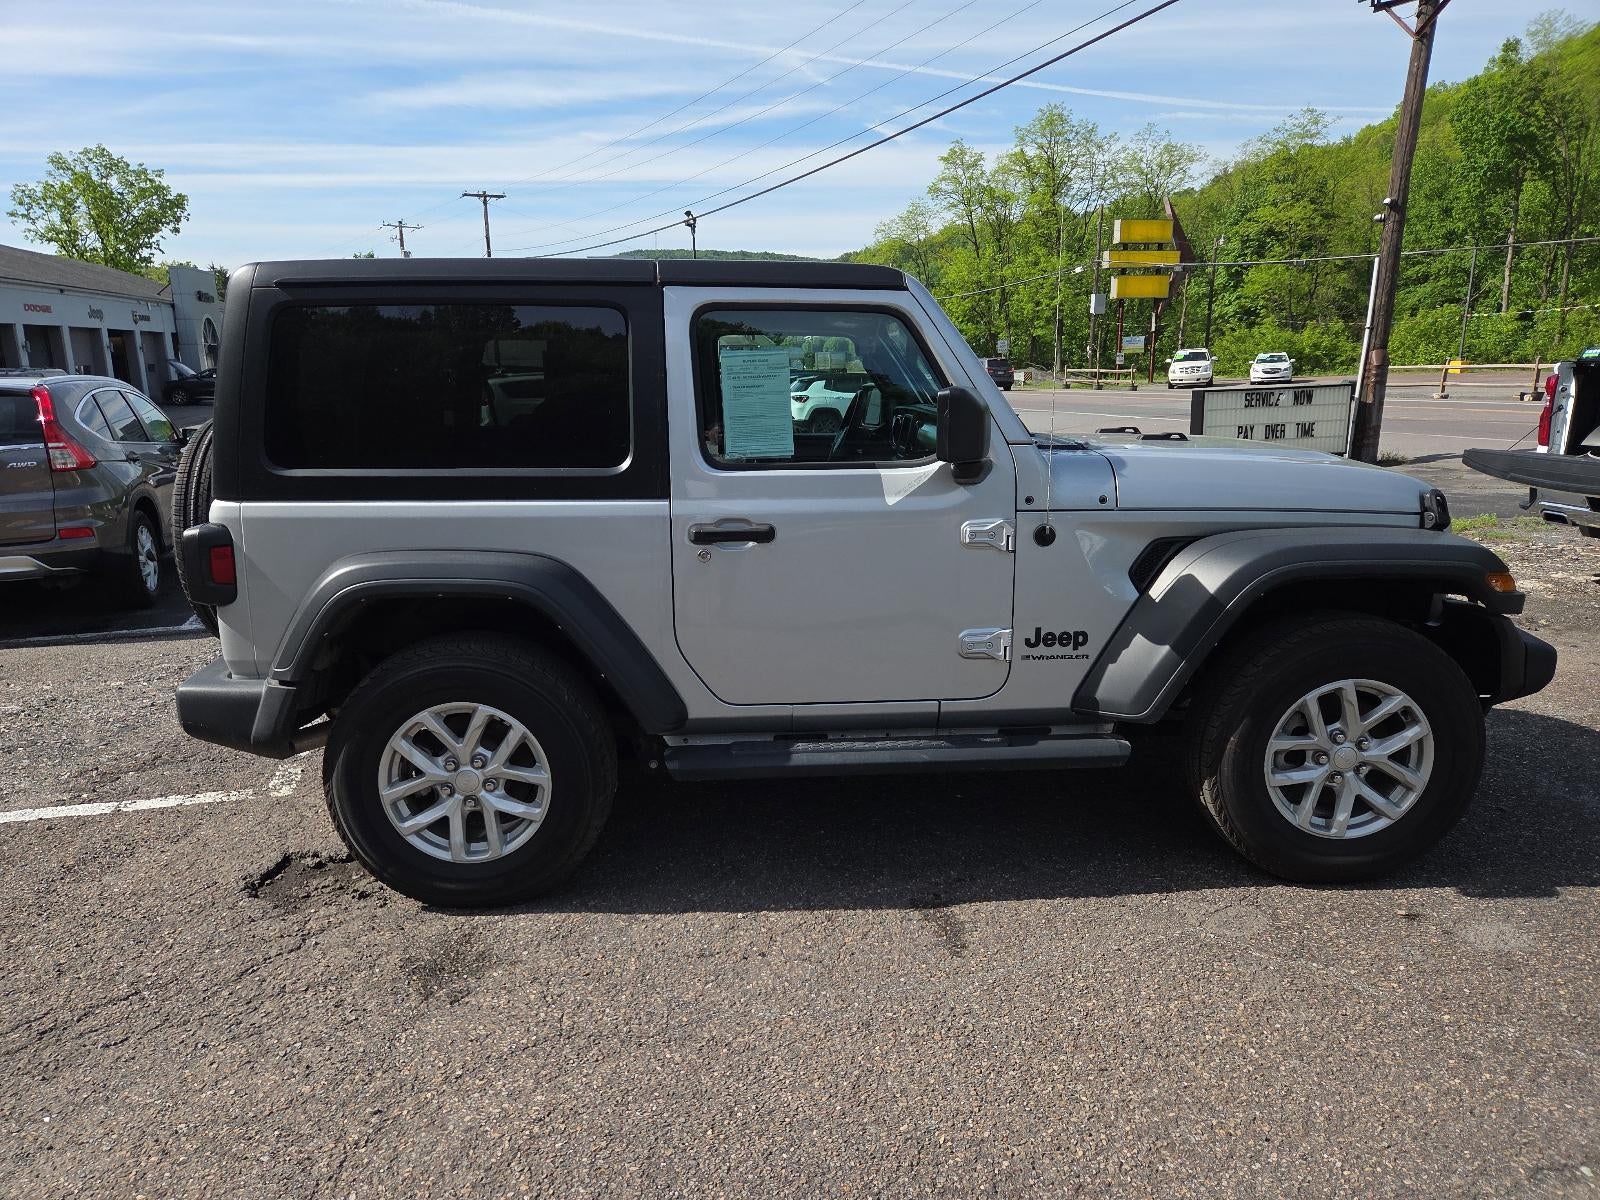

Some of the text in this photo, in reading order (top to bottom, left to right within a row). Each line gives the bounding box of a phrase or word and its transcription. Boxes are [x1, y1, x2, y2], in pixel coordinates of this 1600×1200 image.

[23, 303, 52, 313] DODGE
[88, 304, 104, 322] Jeep
[1244, 390, 1314, 408] SERVICE NOW
[1237, 422, 1316, 440] PAY OVER TIME
[1024, 626, 1089, 651] Jeep
